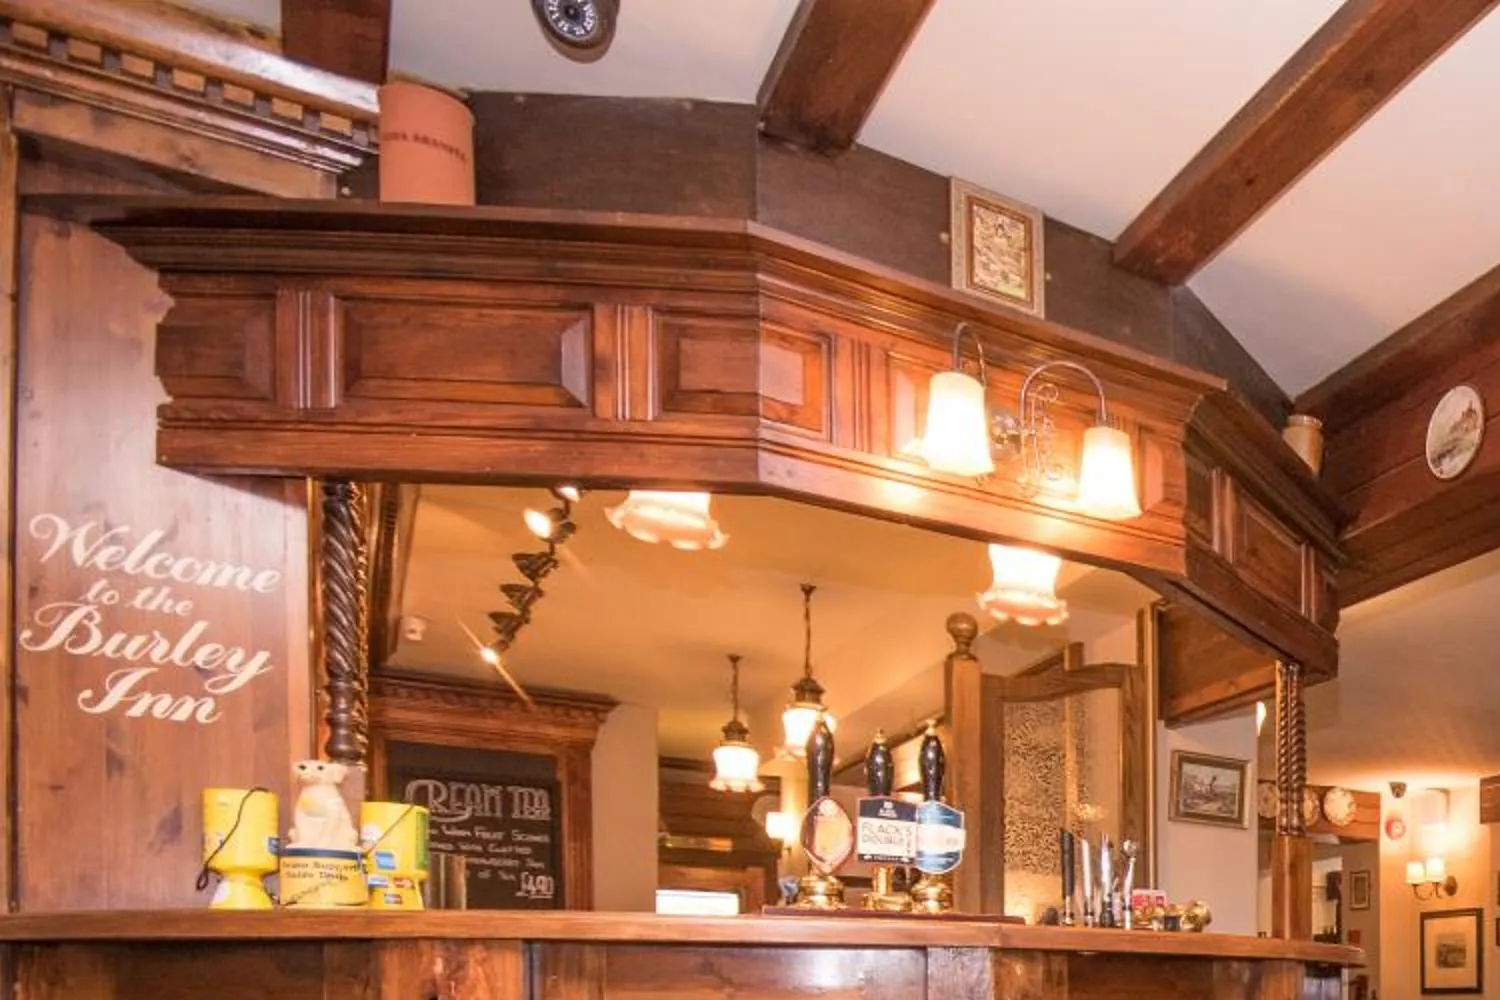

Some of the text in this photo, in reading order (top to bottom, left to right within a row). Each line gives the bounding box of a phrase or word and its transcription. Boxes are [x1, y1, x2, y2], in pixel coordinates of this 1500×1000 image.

[29, 514, 282, 593] Welcome
[81, 578, 194, 616] to the
[19, 601, 275, 694] Burley
[77, 666, 223, 724] Inn
